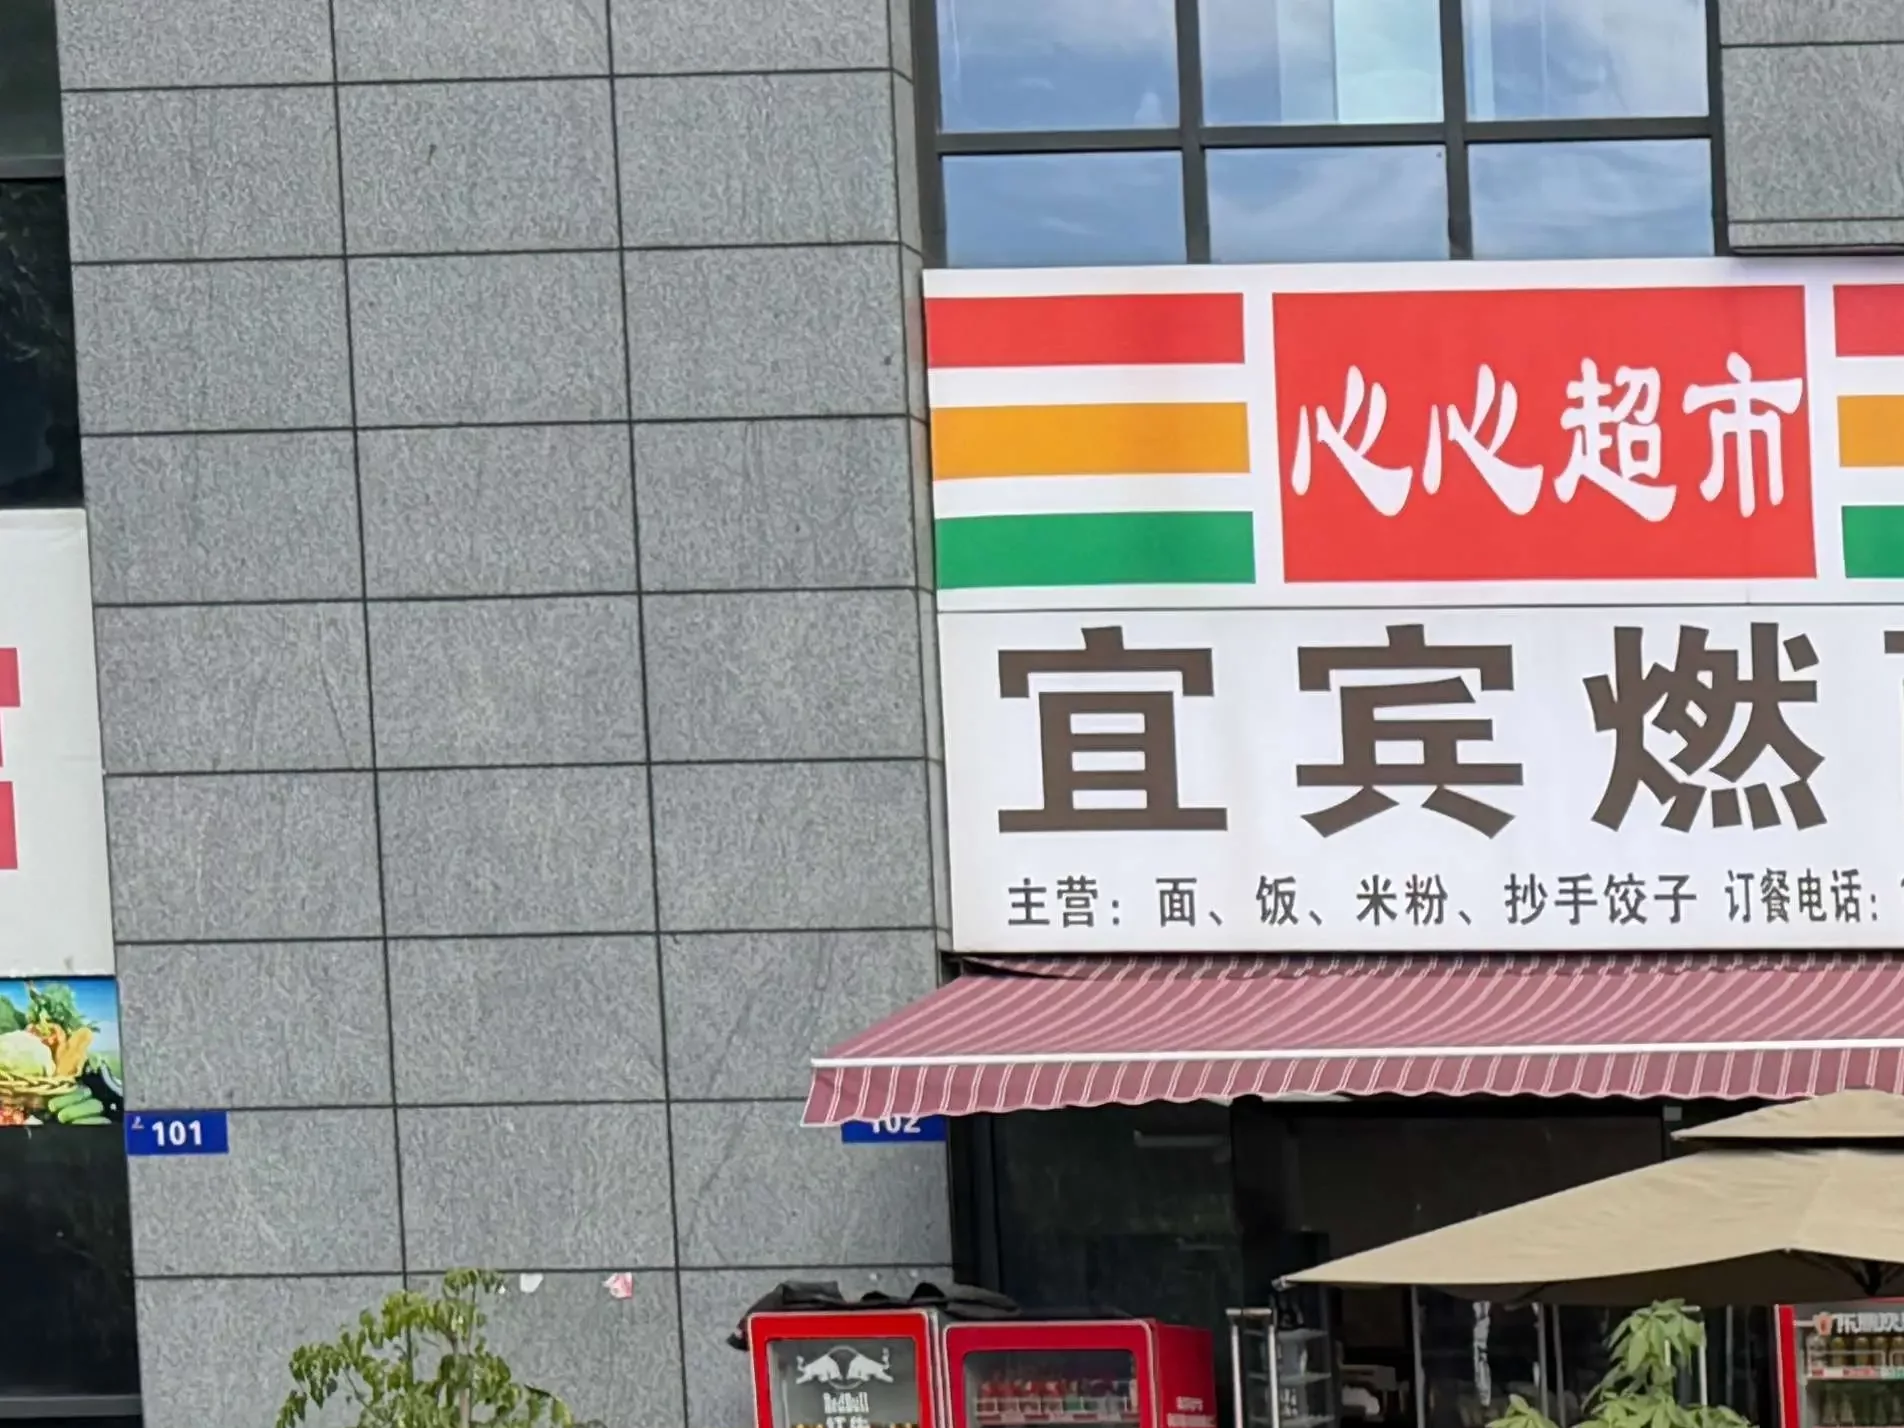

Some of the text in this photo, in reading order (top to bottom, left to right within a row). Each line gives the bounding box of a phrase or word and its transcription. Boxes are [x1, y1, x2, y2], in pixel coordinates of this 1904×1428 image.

[1292, 351, 1804, 522] 心心超市
[152, 1120, 202, 1146] 101
